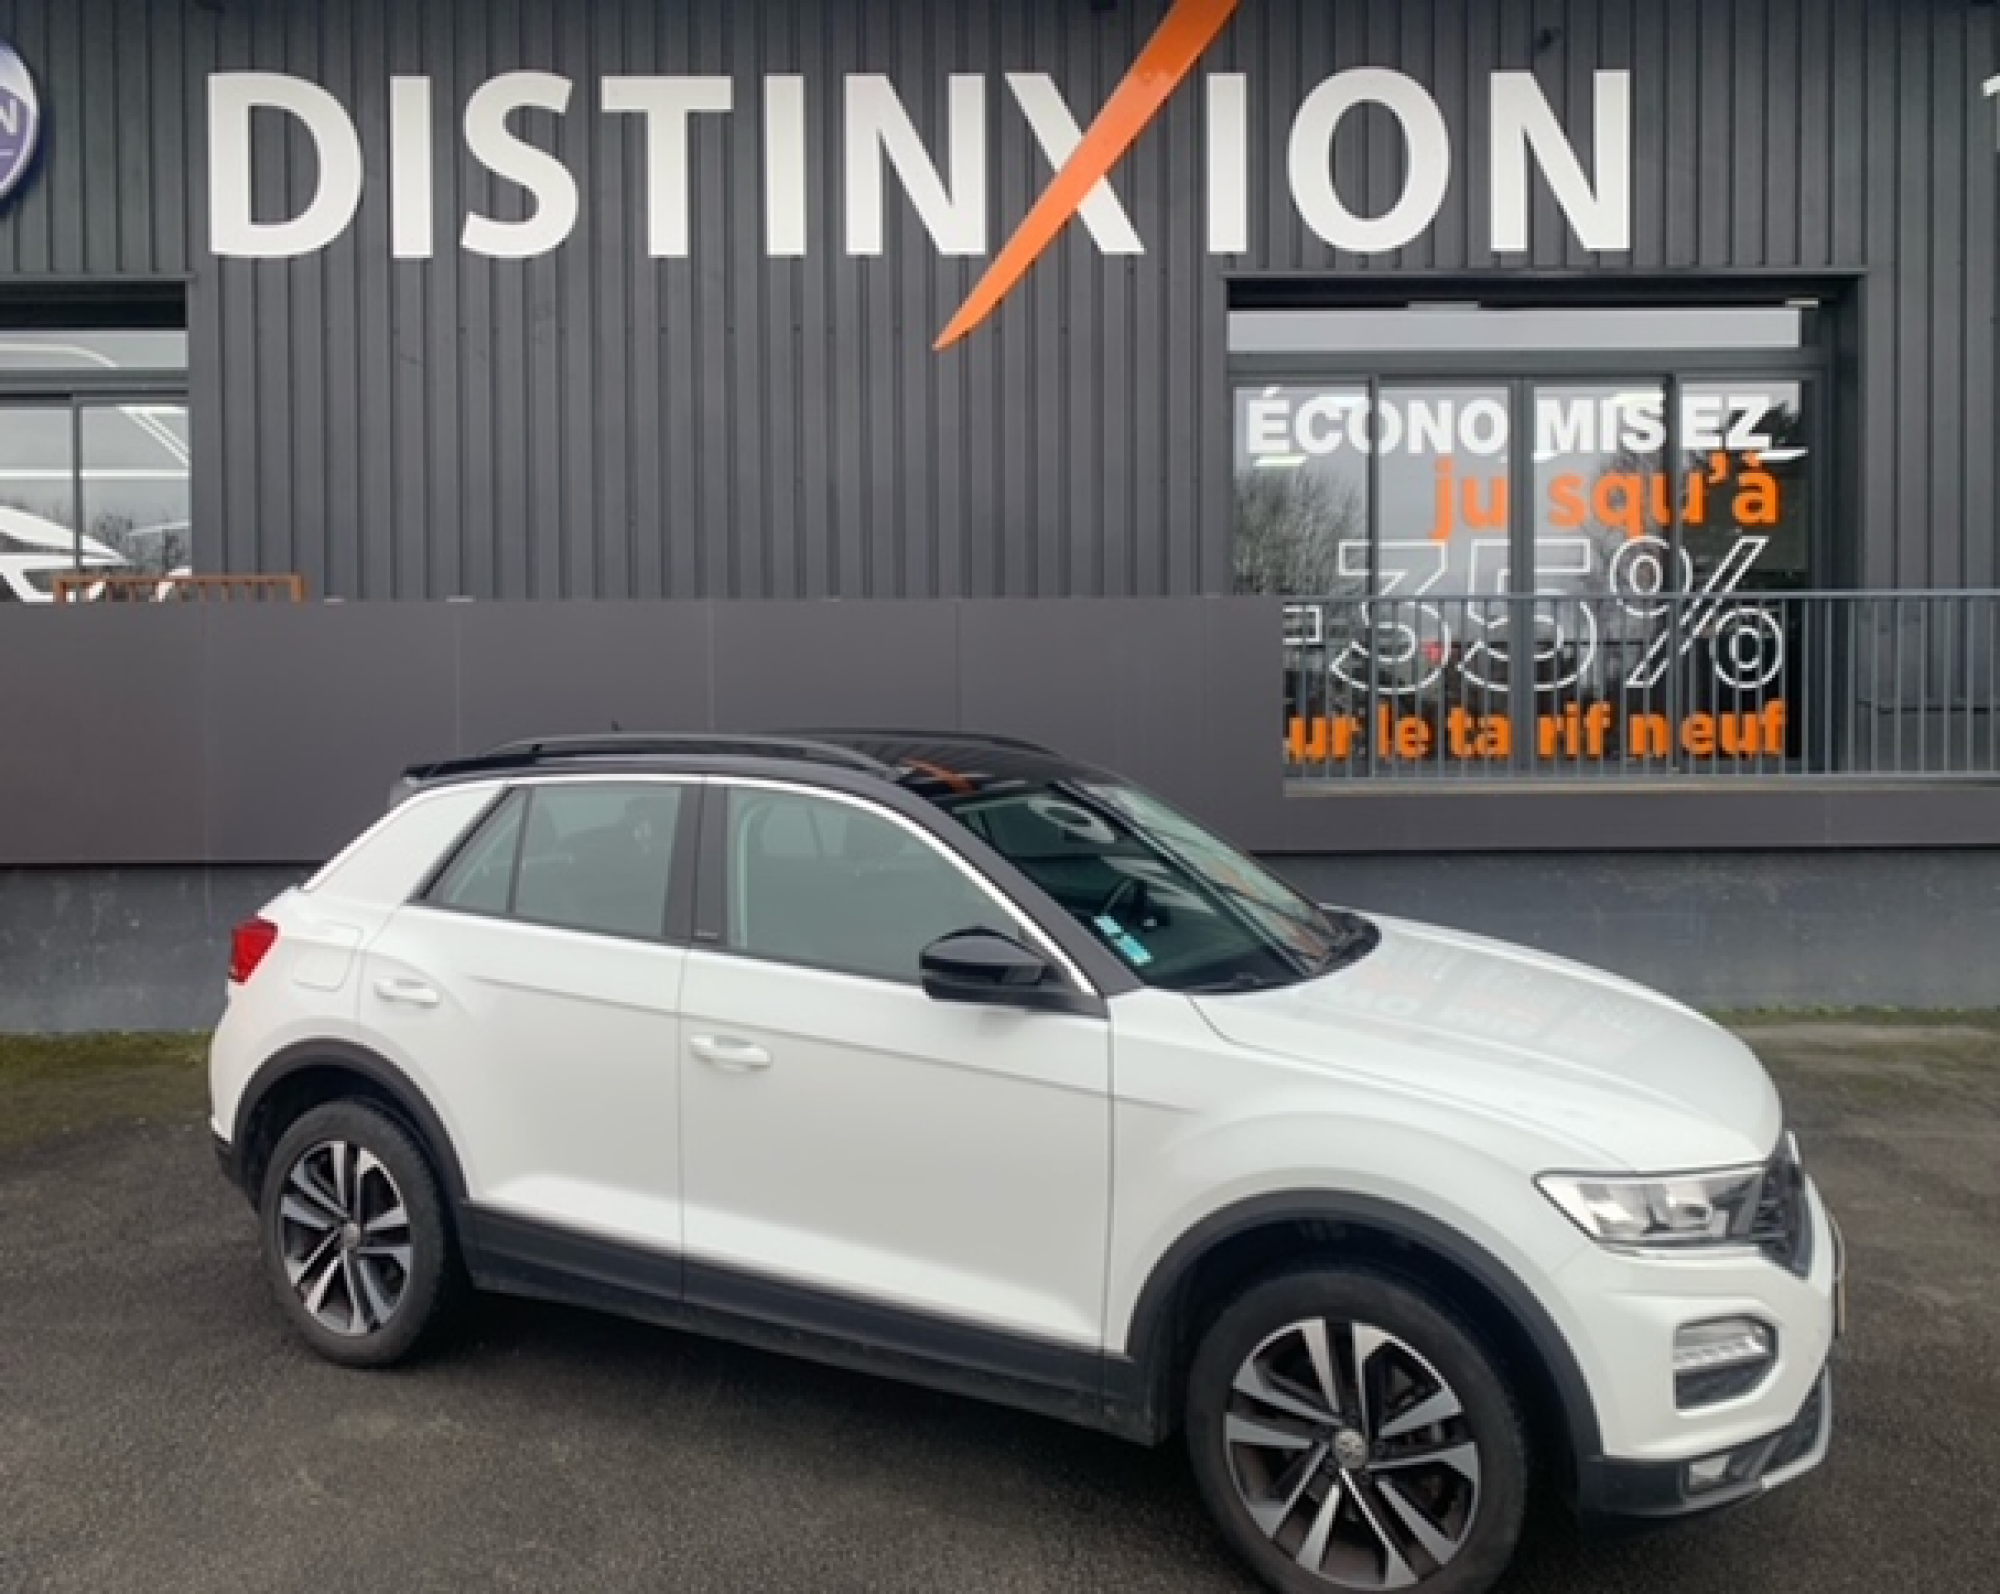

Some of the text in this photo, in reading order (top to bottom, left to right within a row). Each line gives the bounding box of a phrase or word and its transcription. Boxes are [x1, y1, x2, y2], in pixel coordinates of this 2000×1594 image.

[207, 0, 1632, 350] DISTINXION
[1283, 713, 1360, 762] ur
[1377, 702, 1432, 758] le
